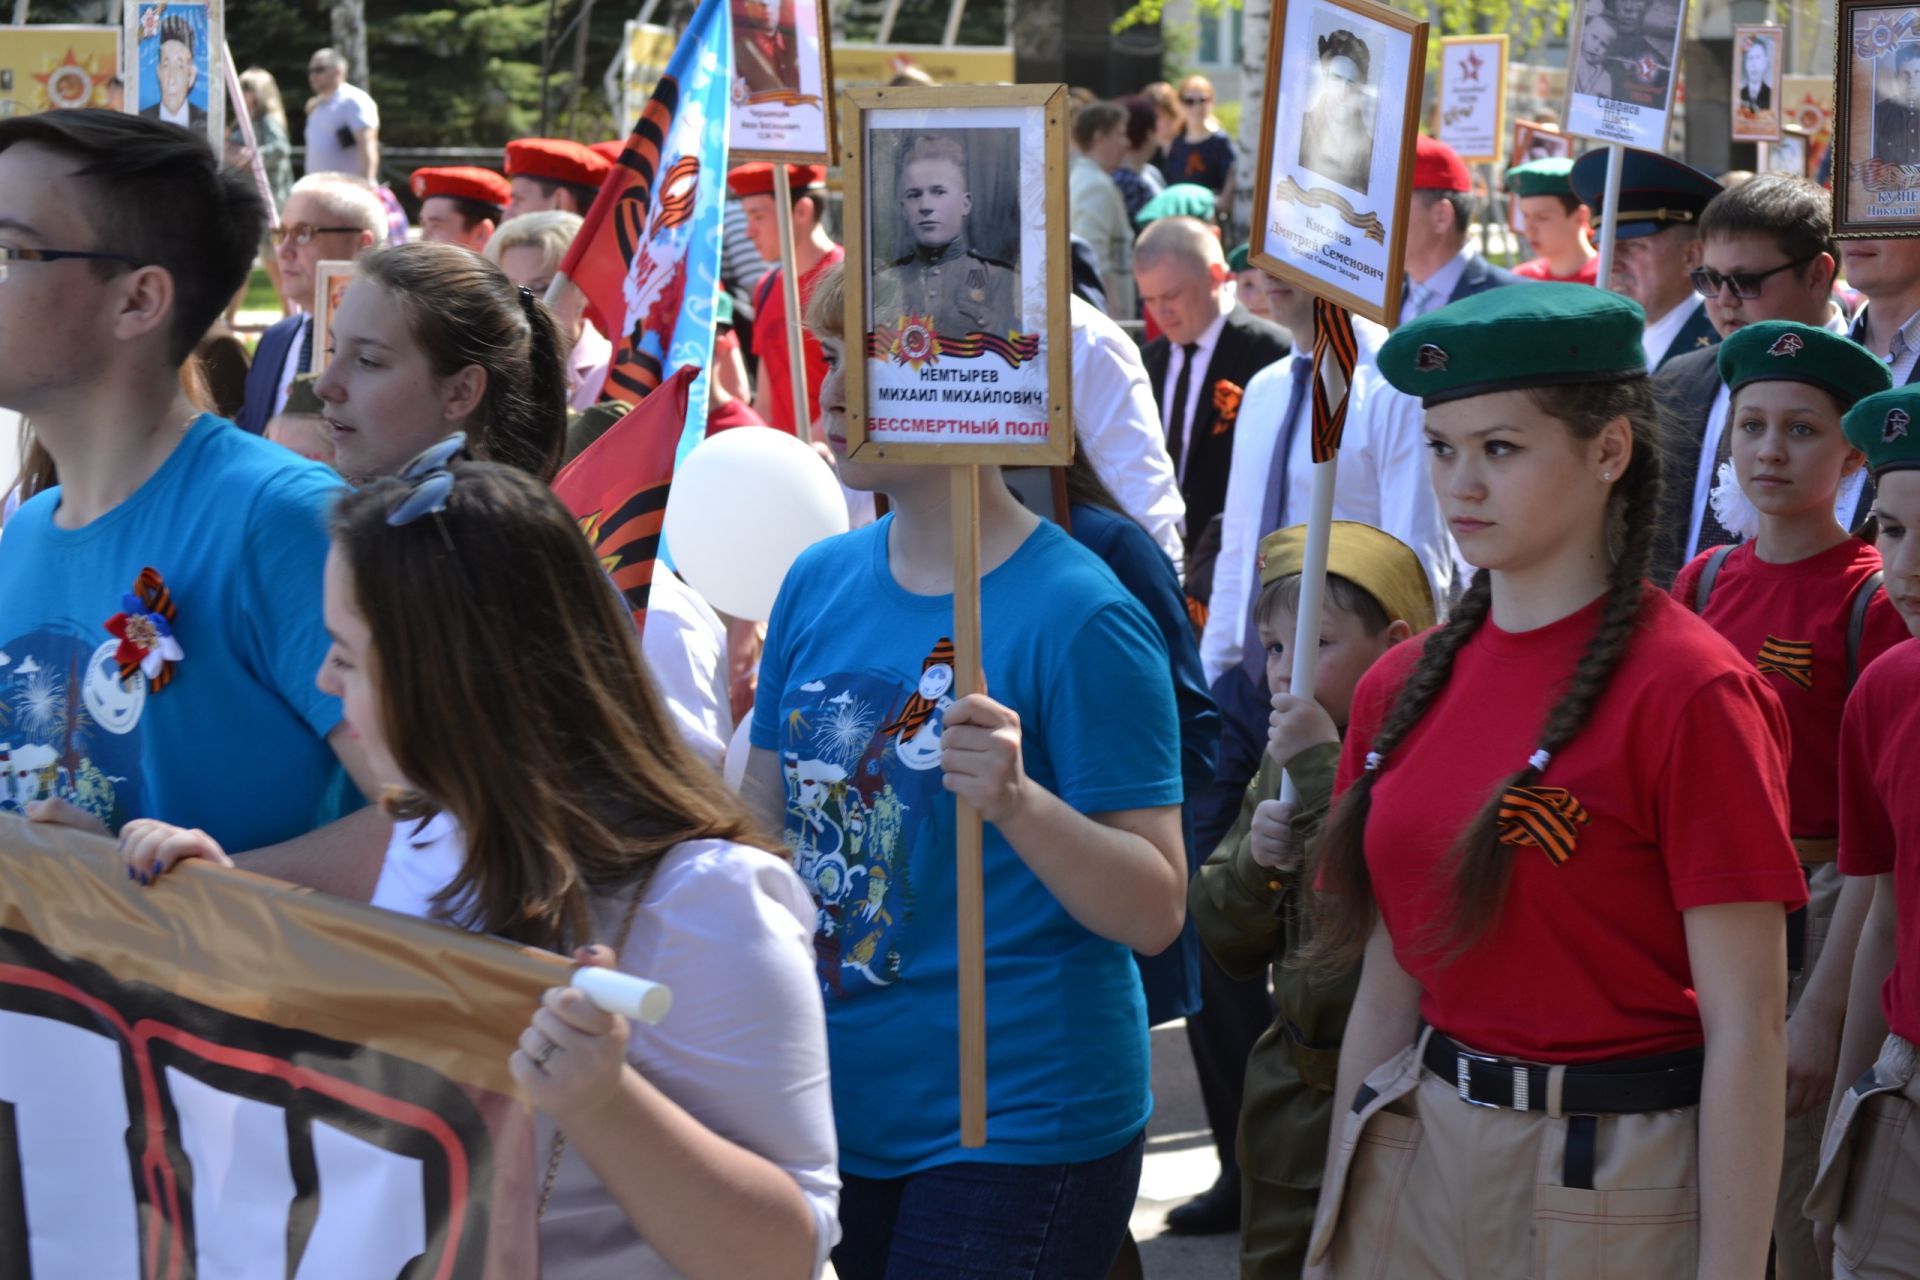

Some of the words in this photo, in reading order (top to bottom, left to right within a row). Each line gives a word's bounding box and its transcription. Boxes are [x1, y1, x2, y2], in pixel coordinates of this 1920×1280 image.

[1867, 205, 1916, 216] Николай
[1305, 216, 1352, 247] Киселев
[1270, 221, 1319, 253] Дмитрий
[1322, 244, 1384, 281] Семенович
[920, 368, 999, 383] НЕМТЫРЕВ
[878, 387, 938, 402] МИХАИЛ
[942, 387, 1042, 405] МИХАЙЛОВИЧ
[866, 417, 999, 435] БЕССМЕРТНЫЙ
